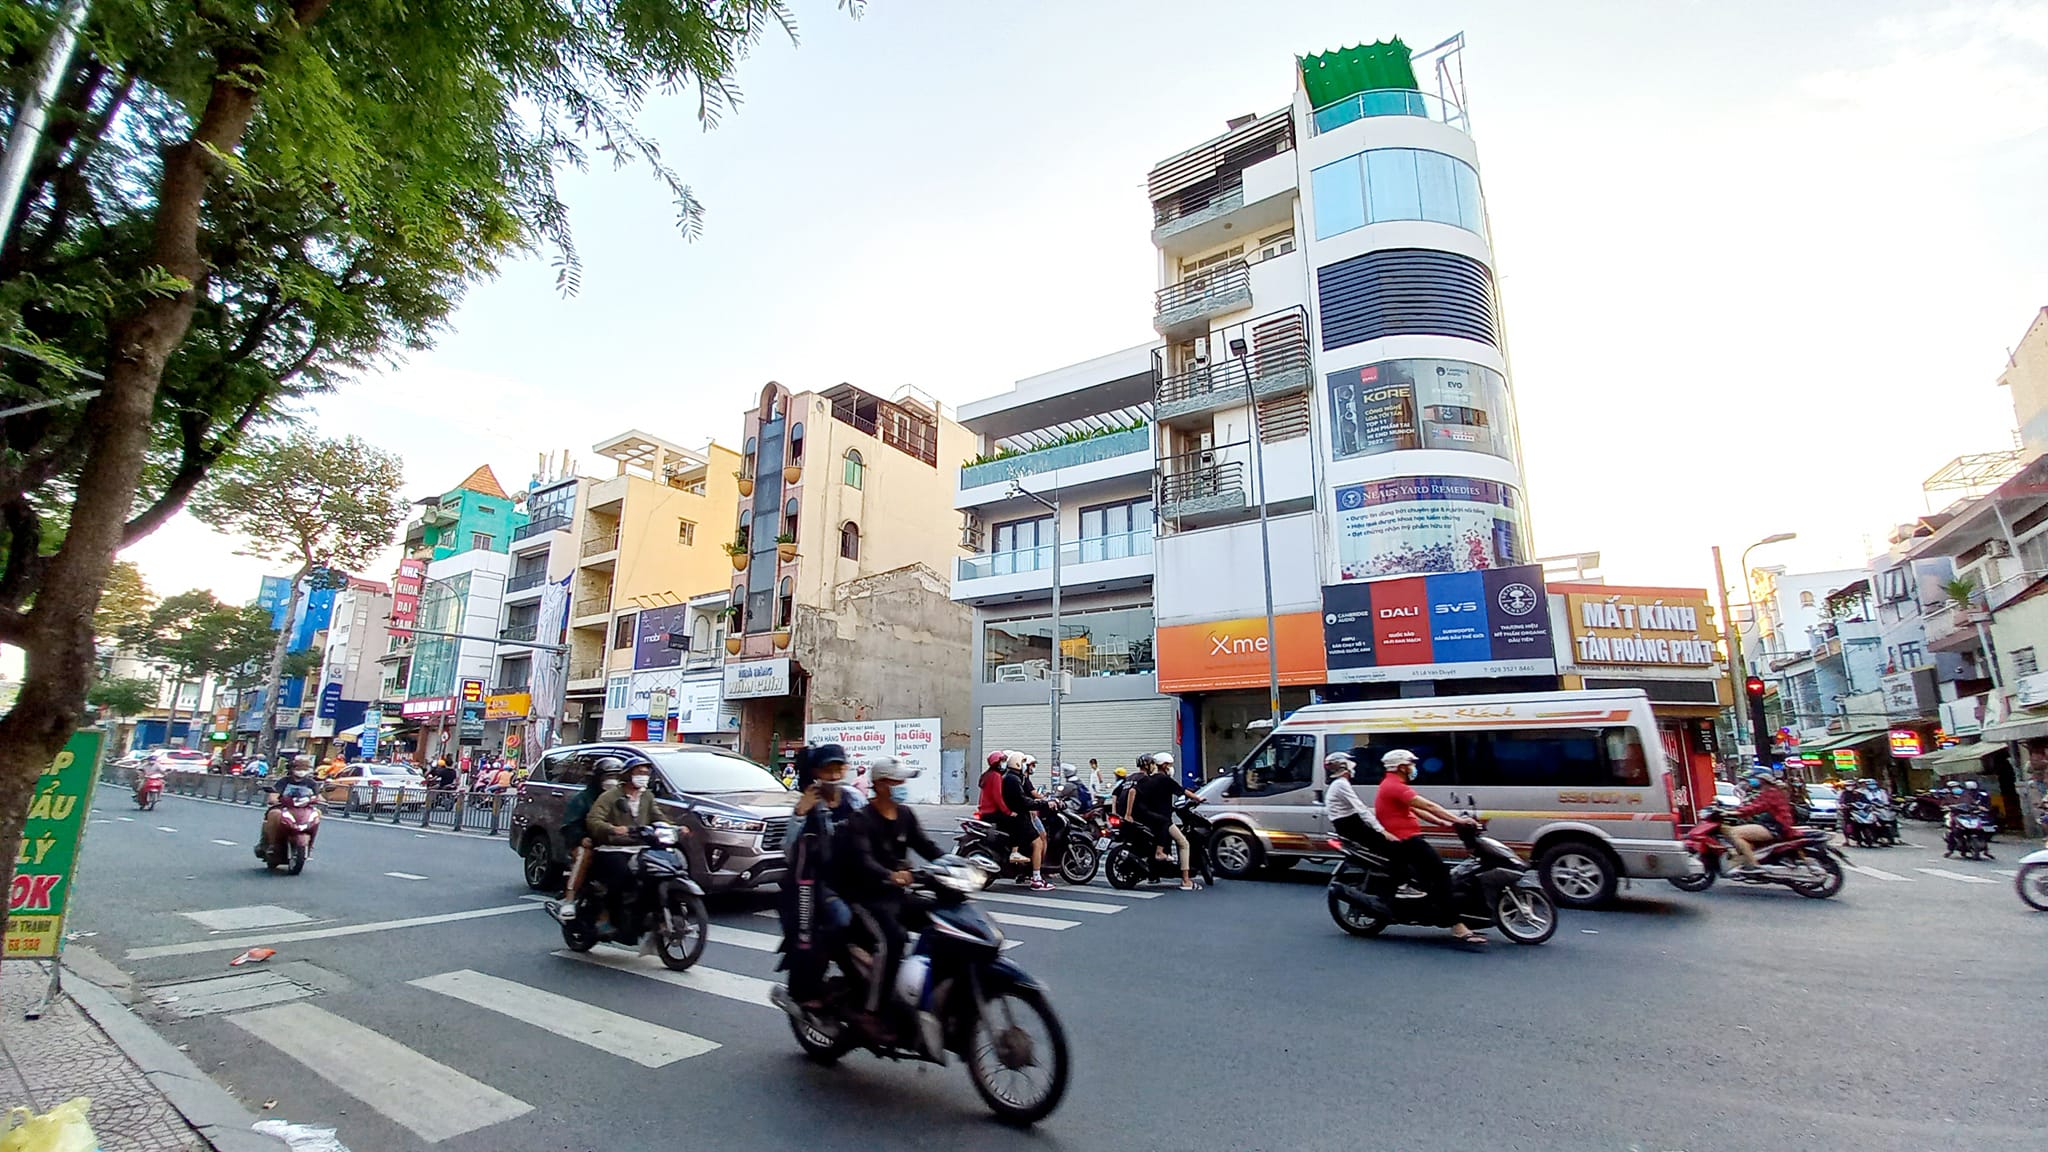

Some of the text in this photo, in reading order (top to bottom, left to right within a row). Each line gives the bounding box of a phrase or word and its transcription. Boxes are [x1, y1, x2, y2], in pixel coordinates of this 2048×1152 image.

[1448, 381, 1463, 389] EVO
[1364, 388, 1411, 404] KORE
[1400, 485, 1430, 495] YARD
[1432, 484, 1480, 496] REMEDIES
[397, 583, 418, 596] KHOA
[1380, 606, 1419, 618] DALI
[1435, 602, 1477, 614] SVS
[1582, 594, 1697, 631] MẮT KÍNH
[1576, 630, 1713, 664] TÂN HOÀNG PHÁT
[840, 732, 864, 742] Vina
[40, 752, 74, 775] P
[15, 832, 56, 864] LÝ
